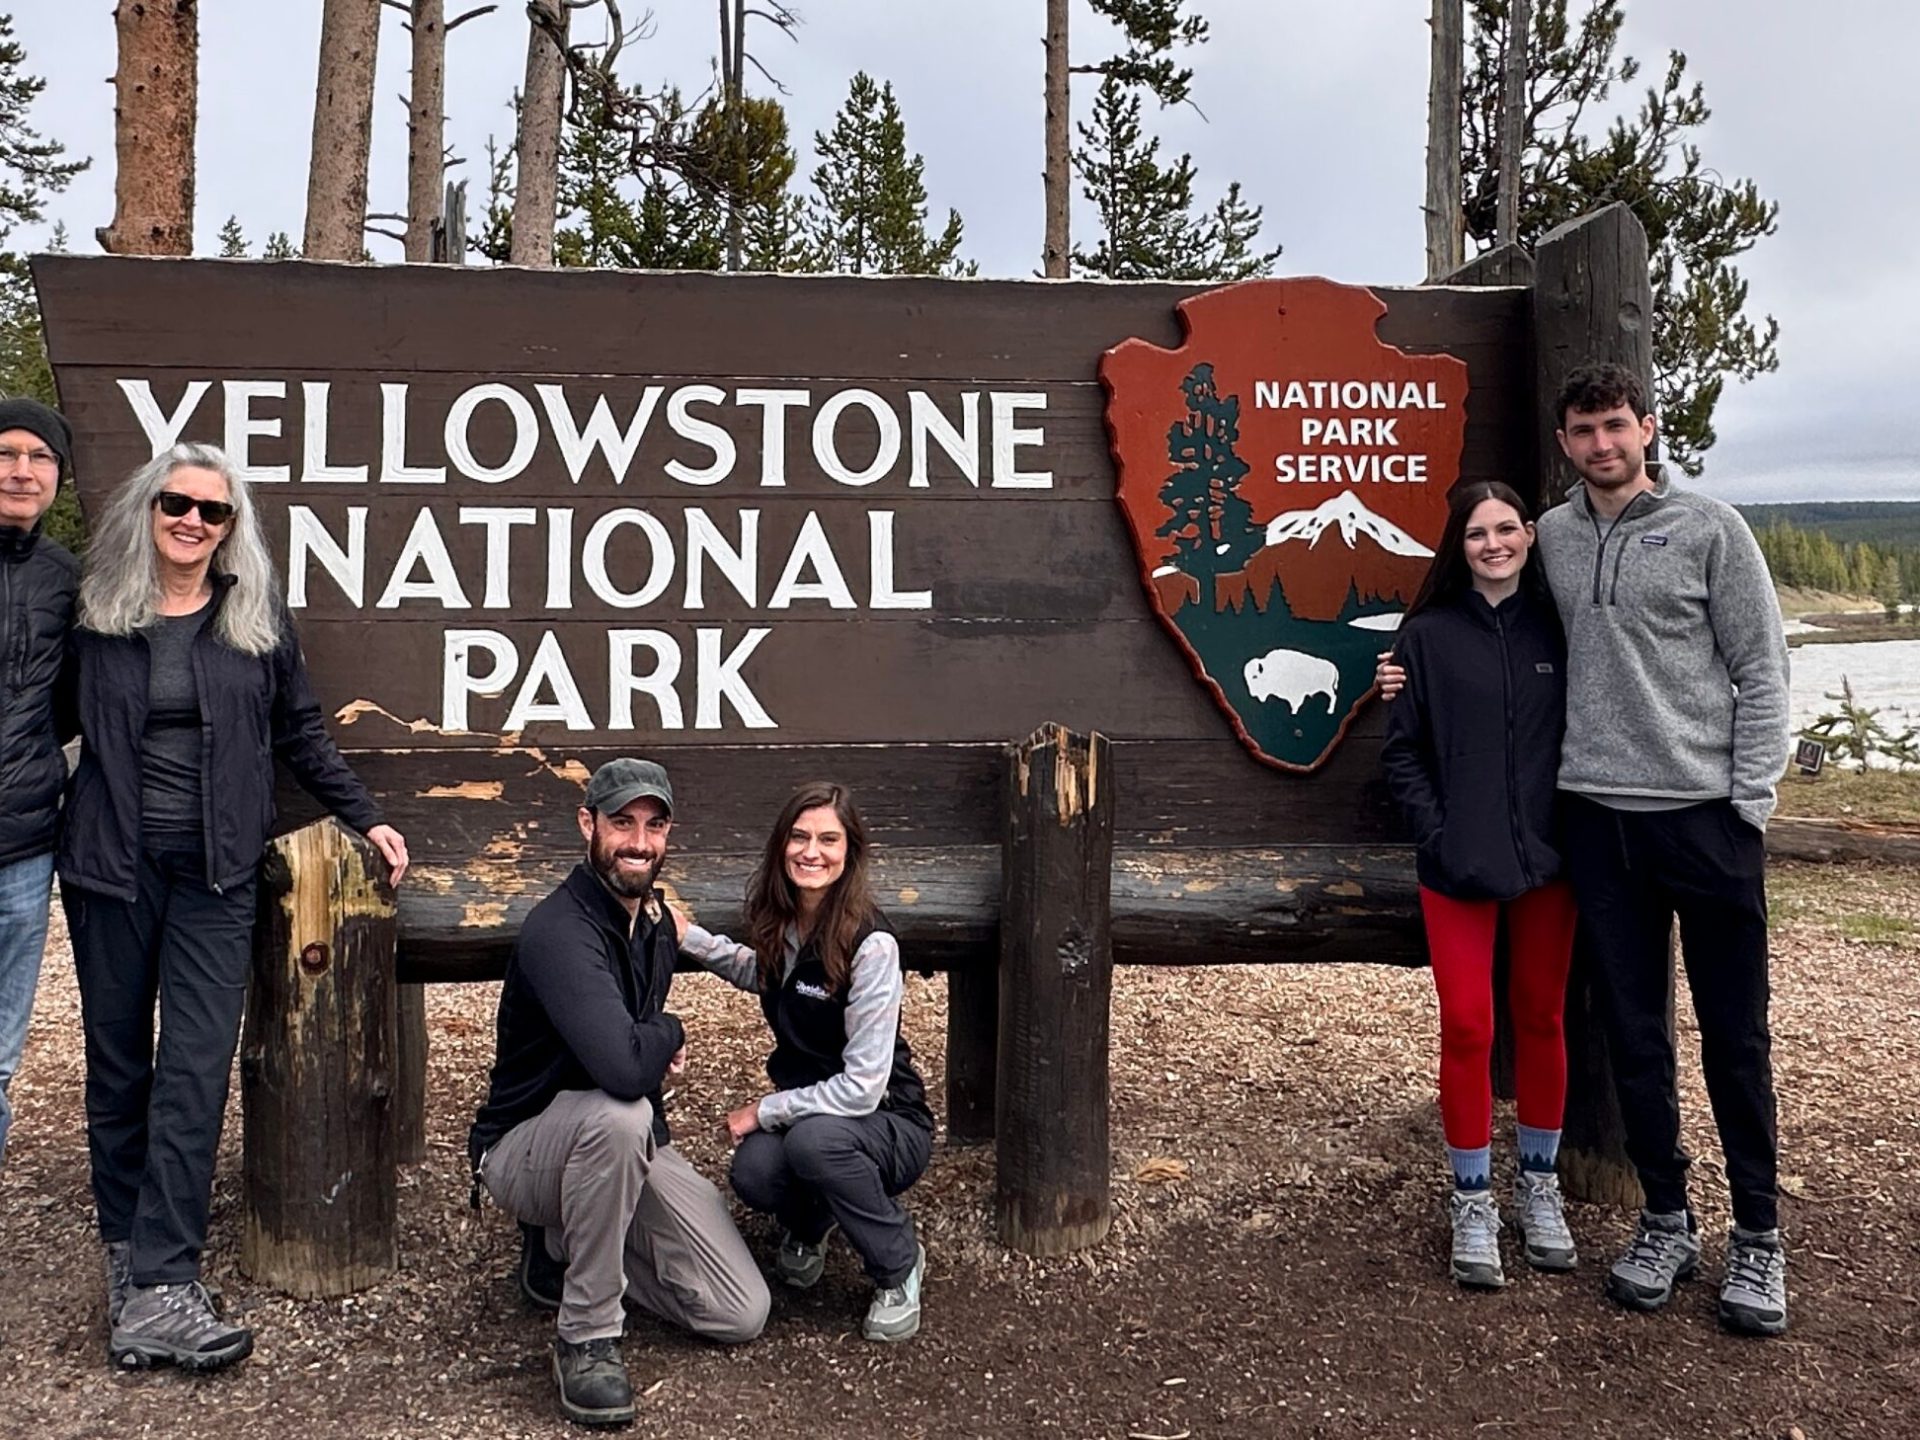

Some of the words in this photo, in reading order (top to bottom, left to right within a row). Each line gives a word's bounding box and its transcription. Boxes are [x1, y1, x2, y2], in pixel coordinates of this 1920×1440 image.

[1254, 381, 1446, 409] NATIONAL
[117, 379, 1053, 488] YELLOWSTONE
[1302, 418, 1399, 446] PARK
[1275, 454, 1428, 483] SERVICE
[288, 506, 932, 608] NATIONAL
[442, 628, 778, 729] PARK
